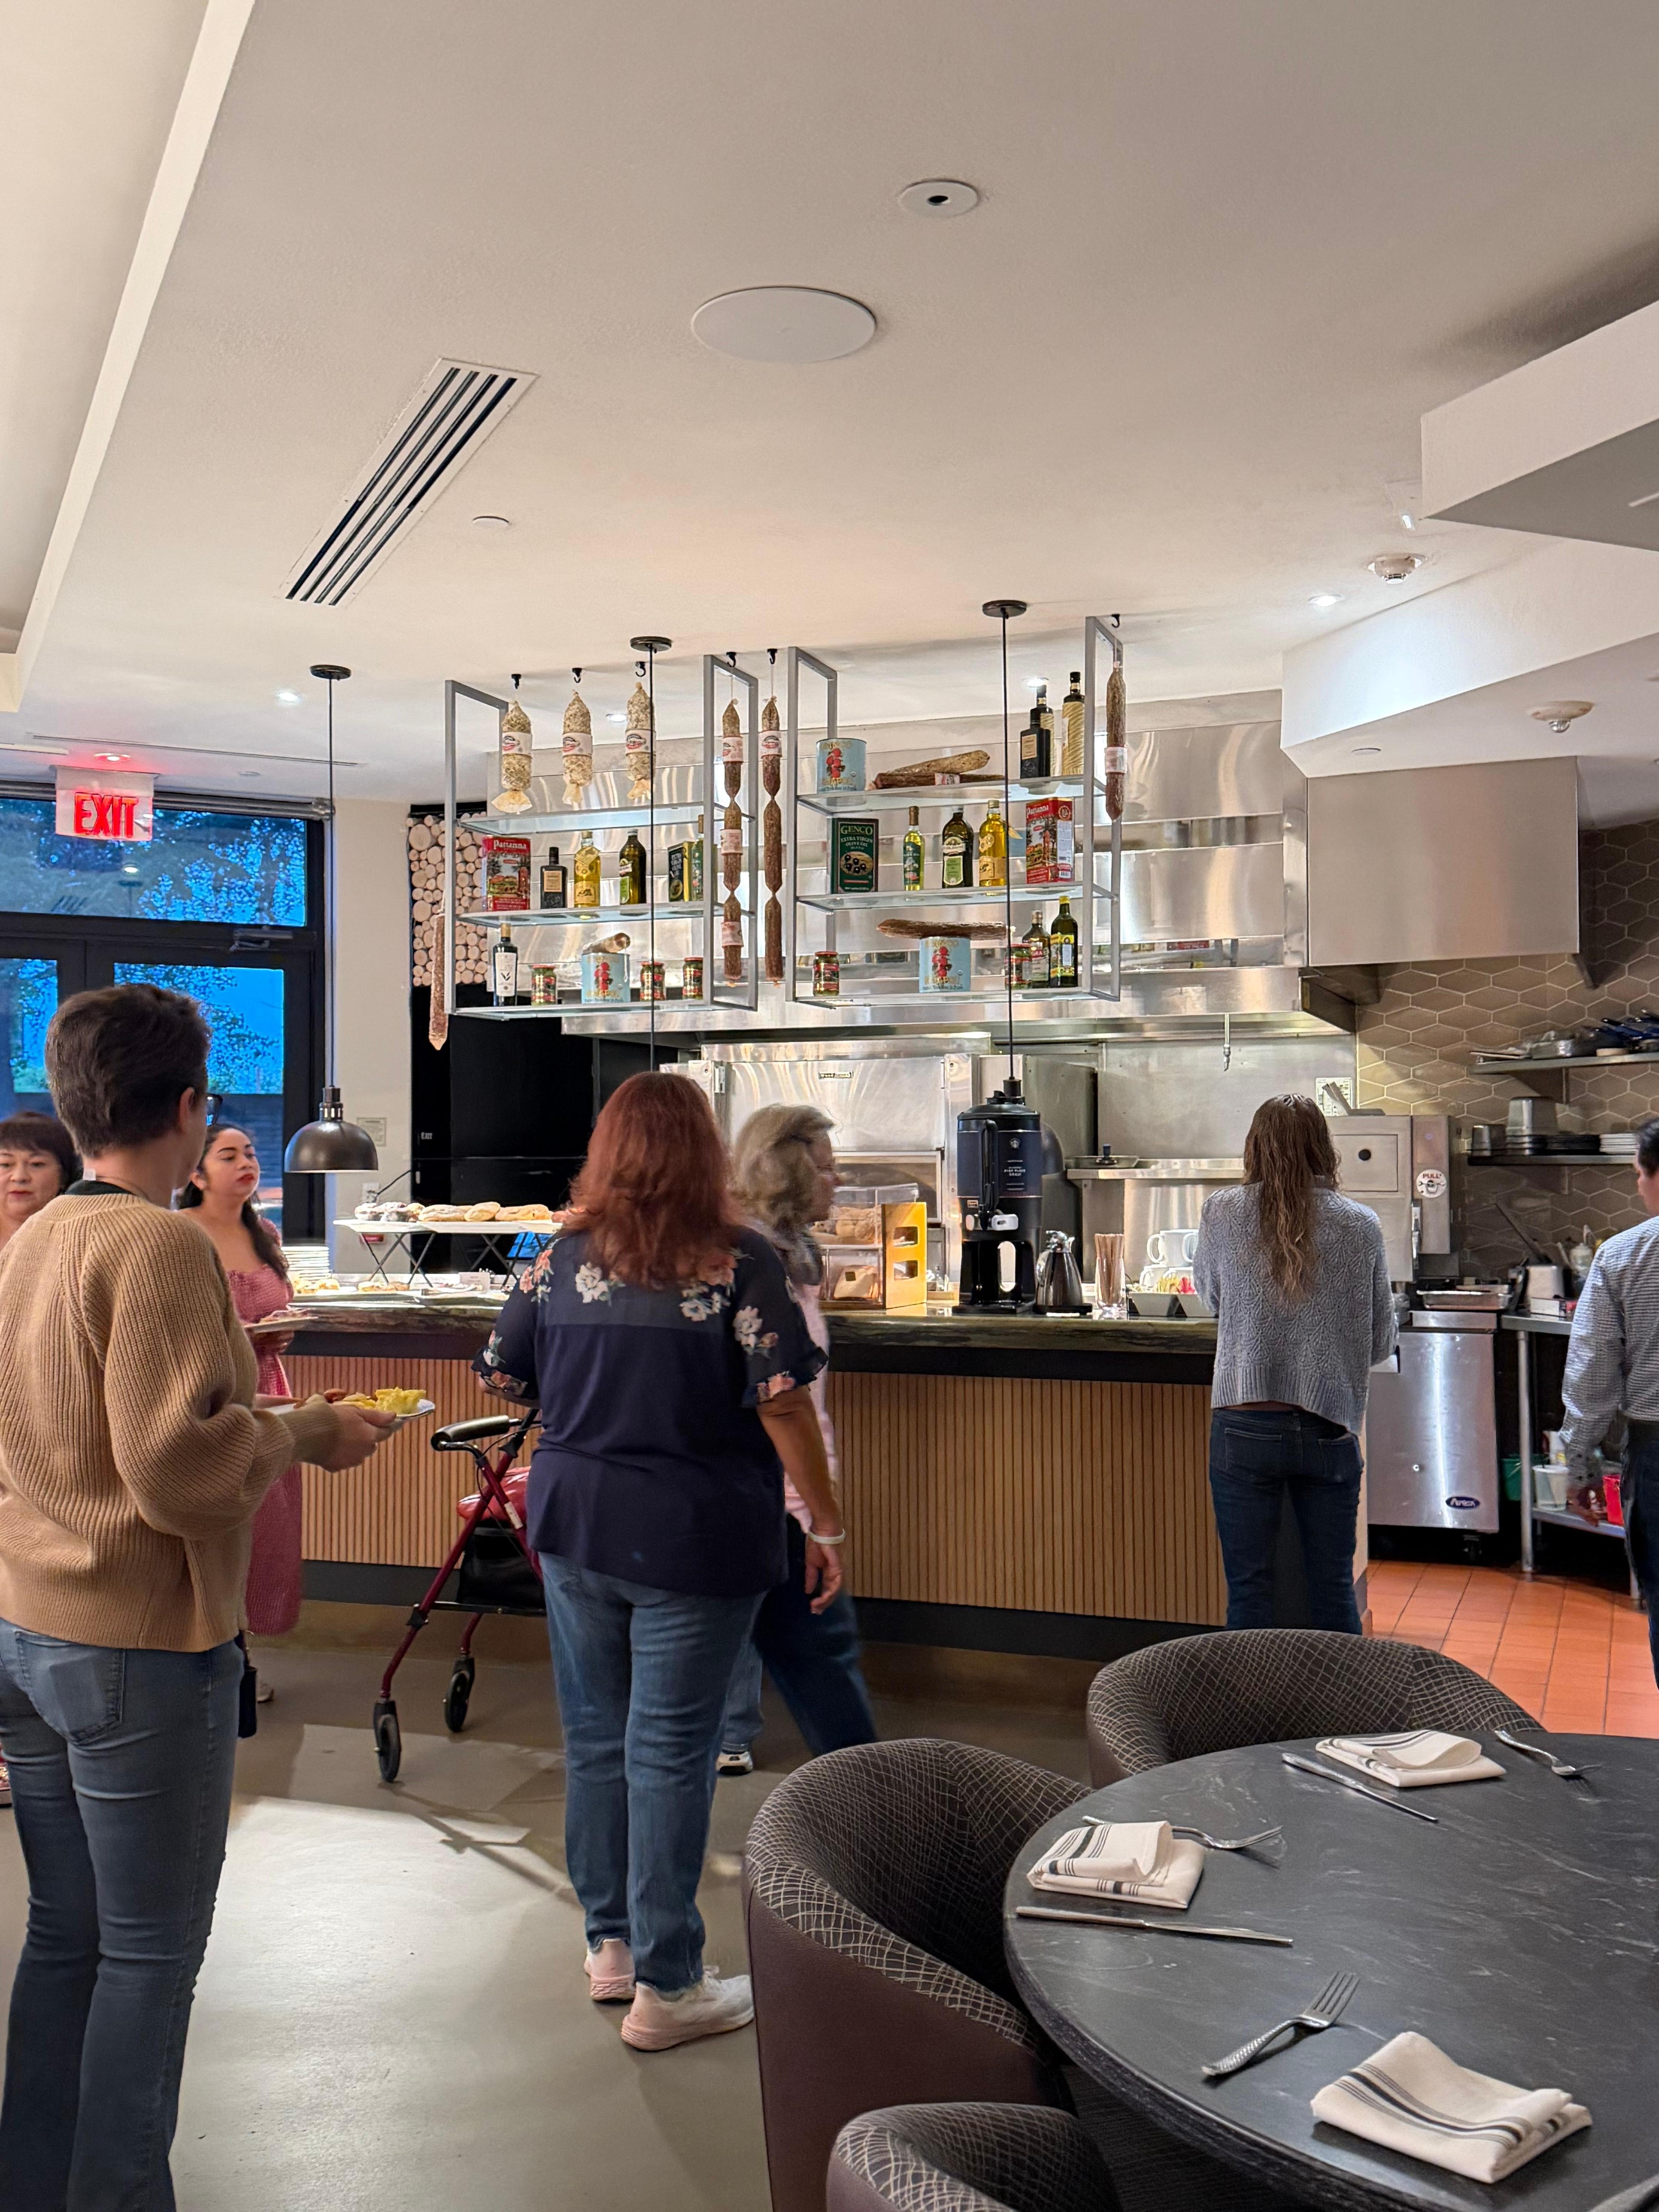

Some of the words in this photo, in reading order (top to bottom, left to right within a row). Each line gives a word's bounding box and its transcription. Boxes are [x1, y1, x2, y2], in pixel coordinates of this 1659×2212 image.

[74, 792, 139, 838] EXIT
[1027, 804, 1049, 819] Partanna
[841, 826, 873, 835] GENCO
[493, 840, 527, 850] Partanna
